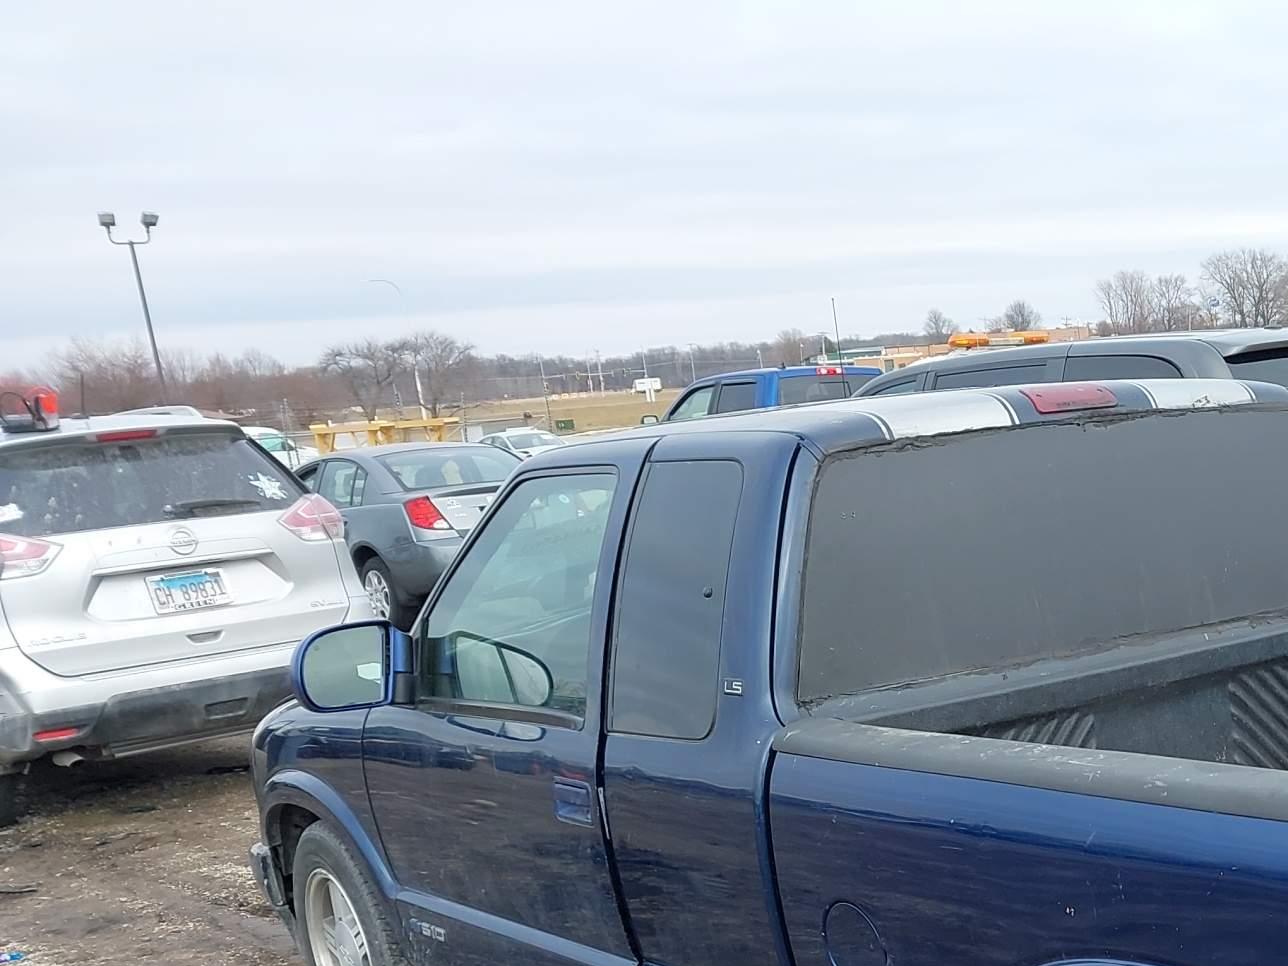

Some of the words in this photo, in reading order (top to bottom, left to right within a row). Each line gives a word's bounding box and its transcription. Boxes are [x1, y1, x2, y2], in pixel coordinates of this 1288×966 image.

[154, 586, 175, 606] CH
[180, 578, 226, 601] 89831
[724, 680, 742, 694] LS
[420, 921, 446, 942] S10
